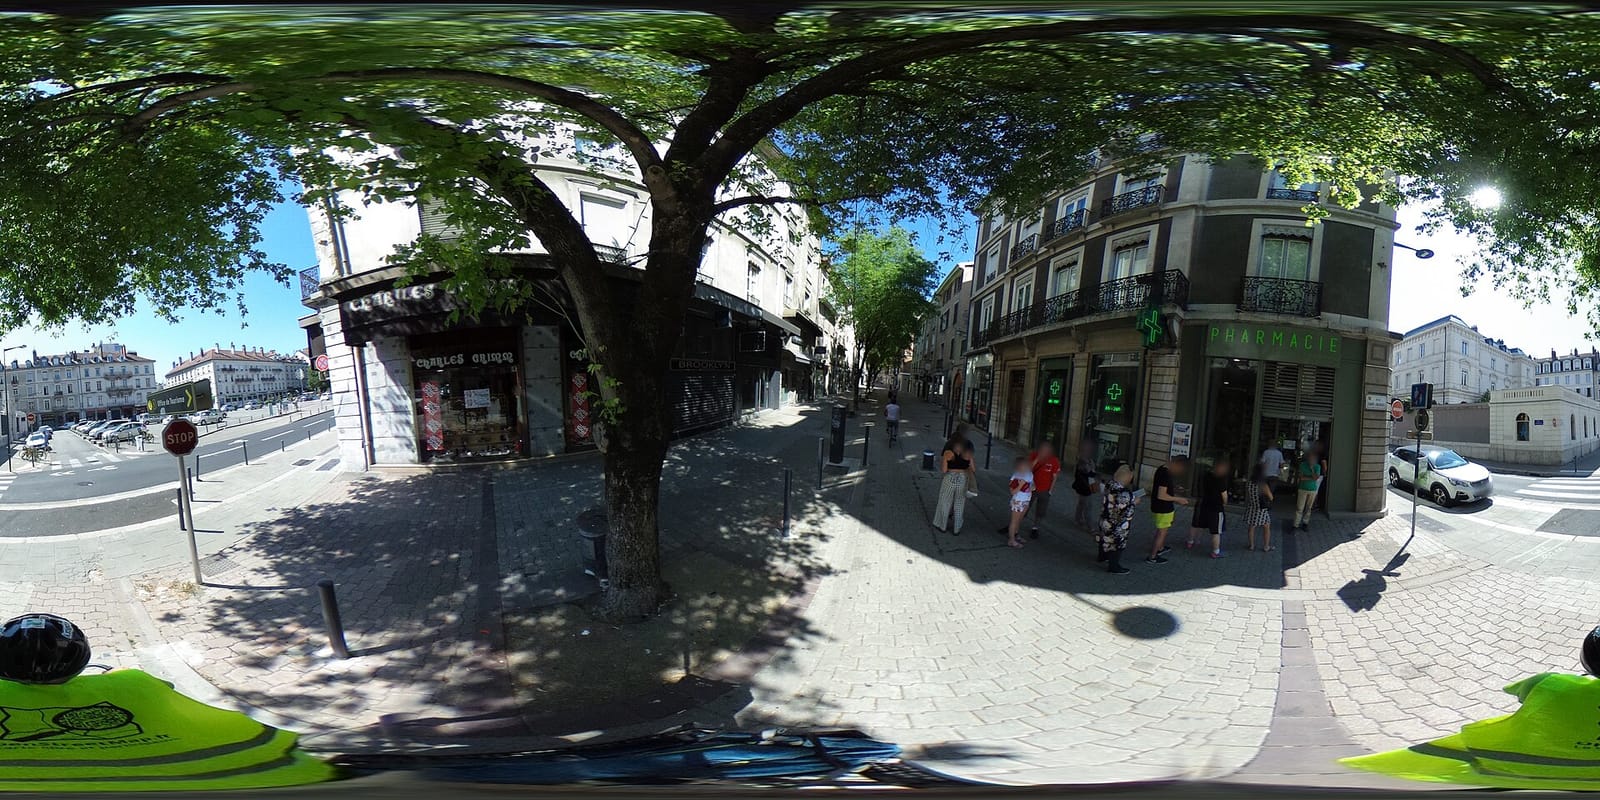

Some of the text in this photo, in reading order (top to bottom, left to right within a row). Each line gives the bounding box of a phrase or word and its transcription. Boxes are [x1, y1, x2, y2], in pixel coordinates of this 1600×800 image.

[1210, 327, 1338, 353] PHARMACIE
[416, 352, 514, 370] CHARLES GRIMM
[678, 359, 731, 369] BROOKLYN
[167, 431, 194, 444] STOP
